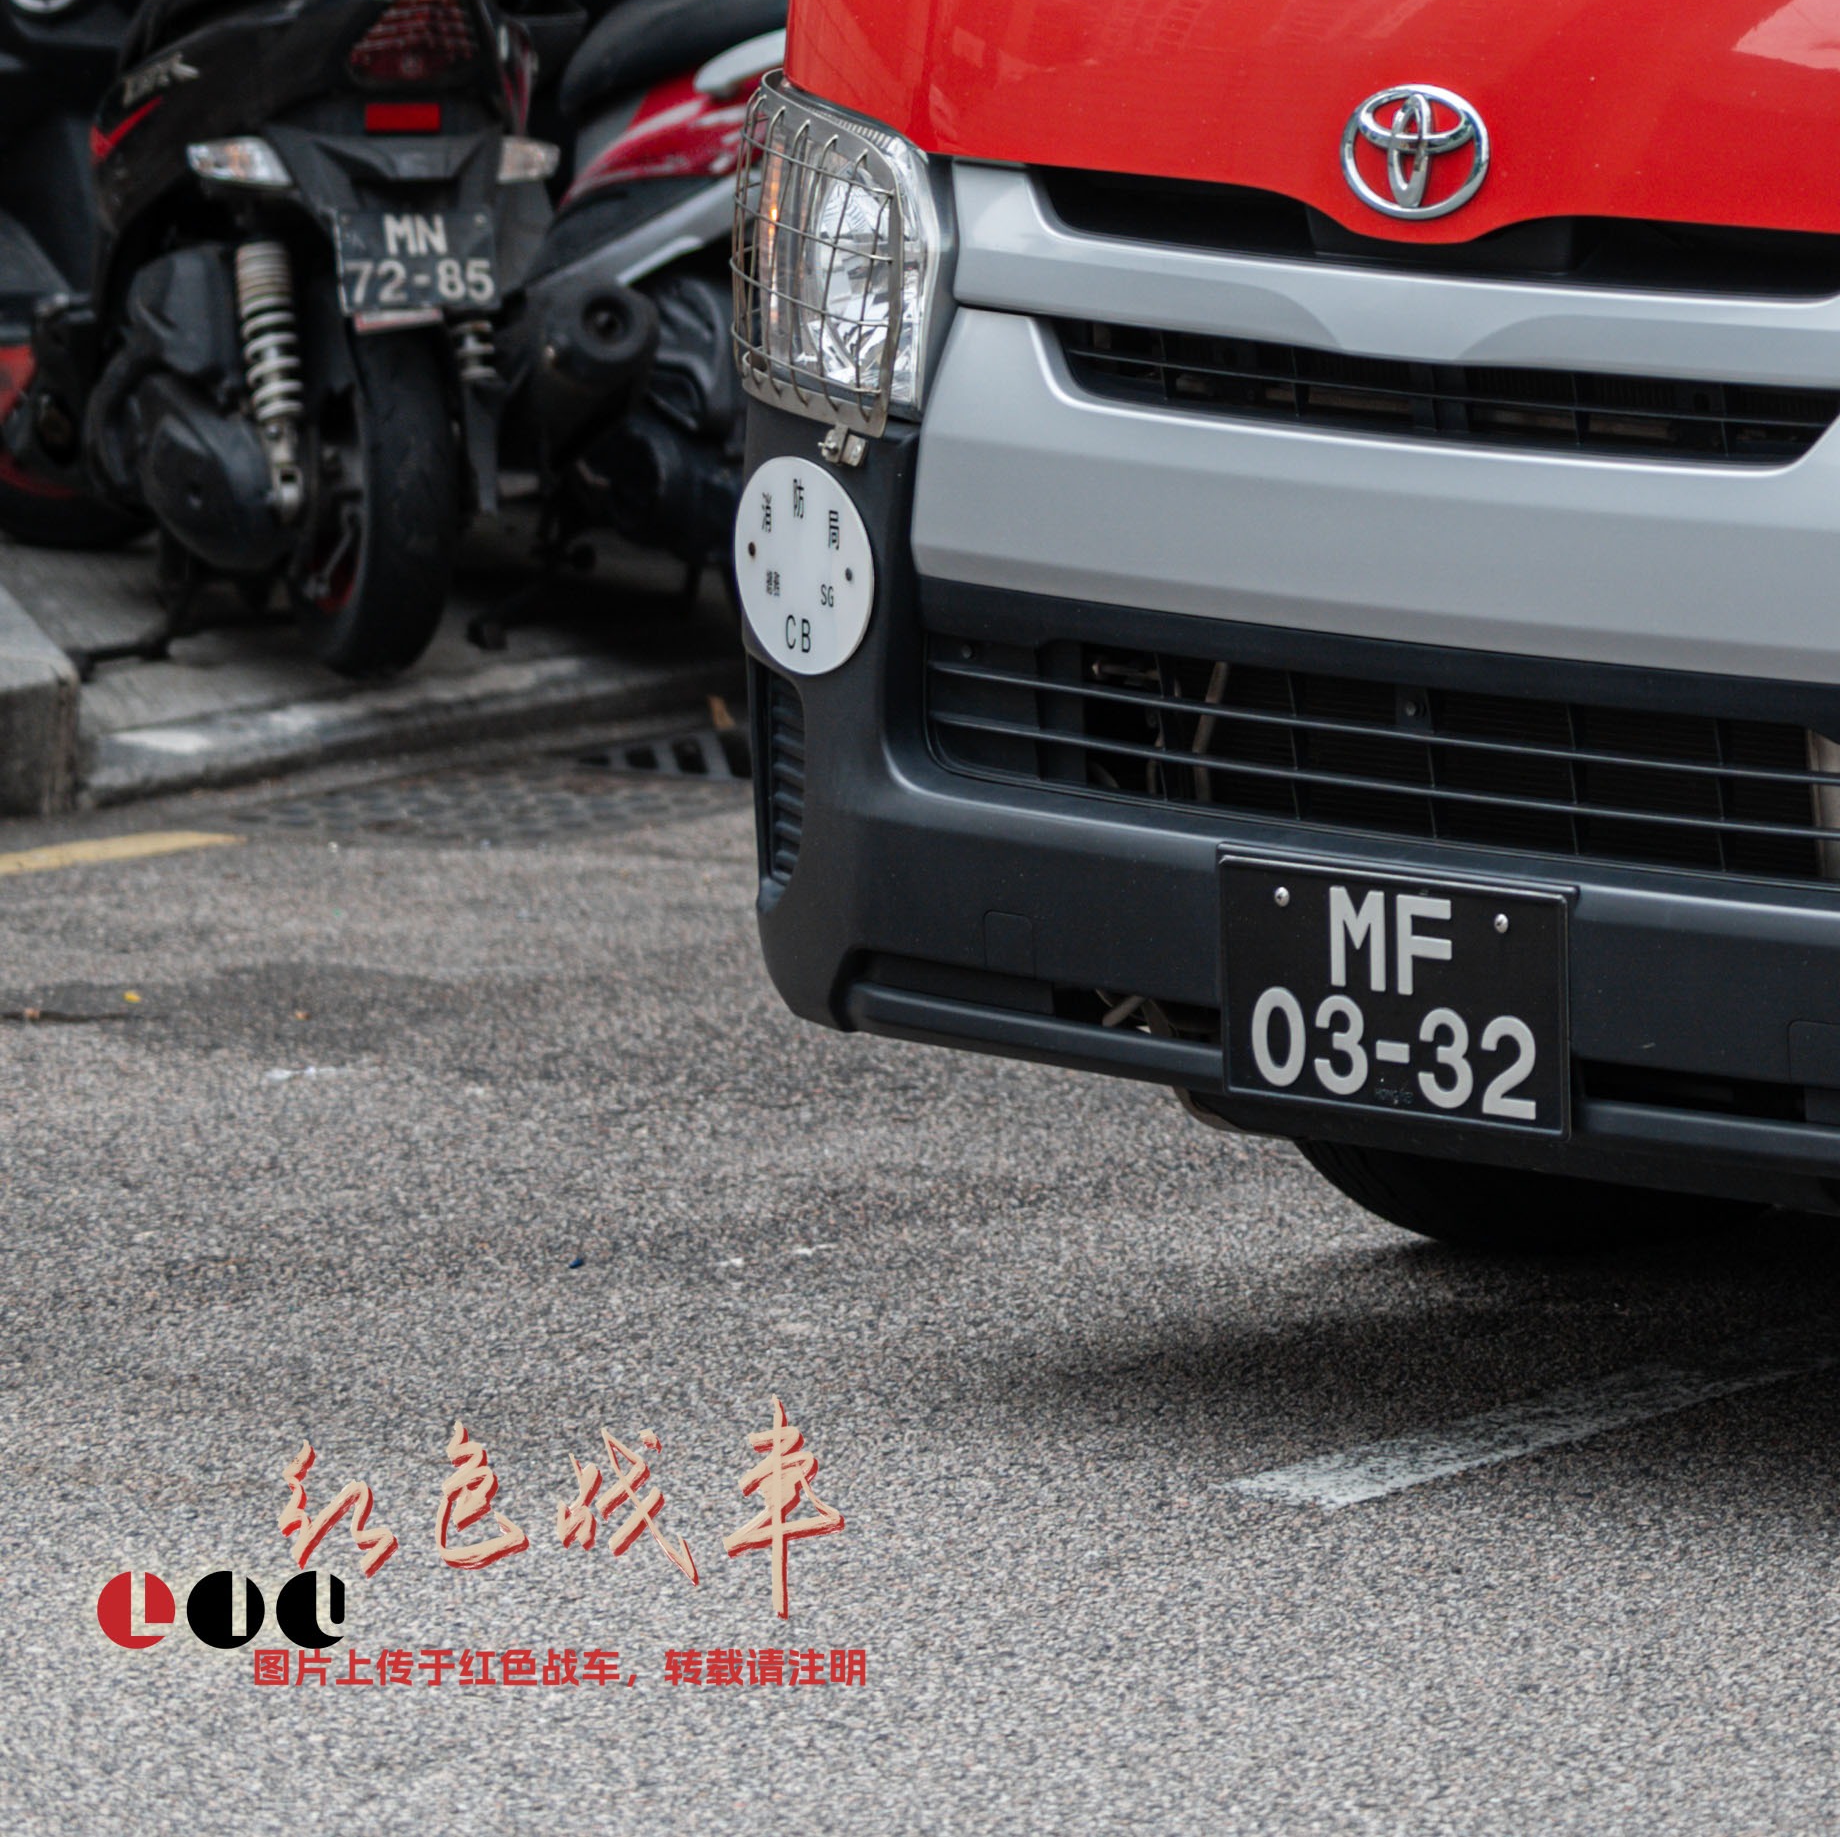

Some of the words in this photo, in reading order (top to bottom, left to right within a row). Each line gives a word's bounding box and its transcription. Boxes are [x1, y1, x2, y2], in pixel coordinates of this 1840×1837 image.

[383, 213, 448, 256] MN
[343, 258, 495, 305] 72-85
[820, 583, 835, 608] SG
[785, 614, 812, 653] CB
[1329, 885, 1453, 996] MF
[1251, 985, 1537, 1120] 03-32
